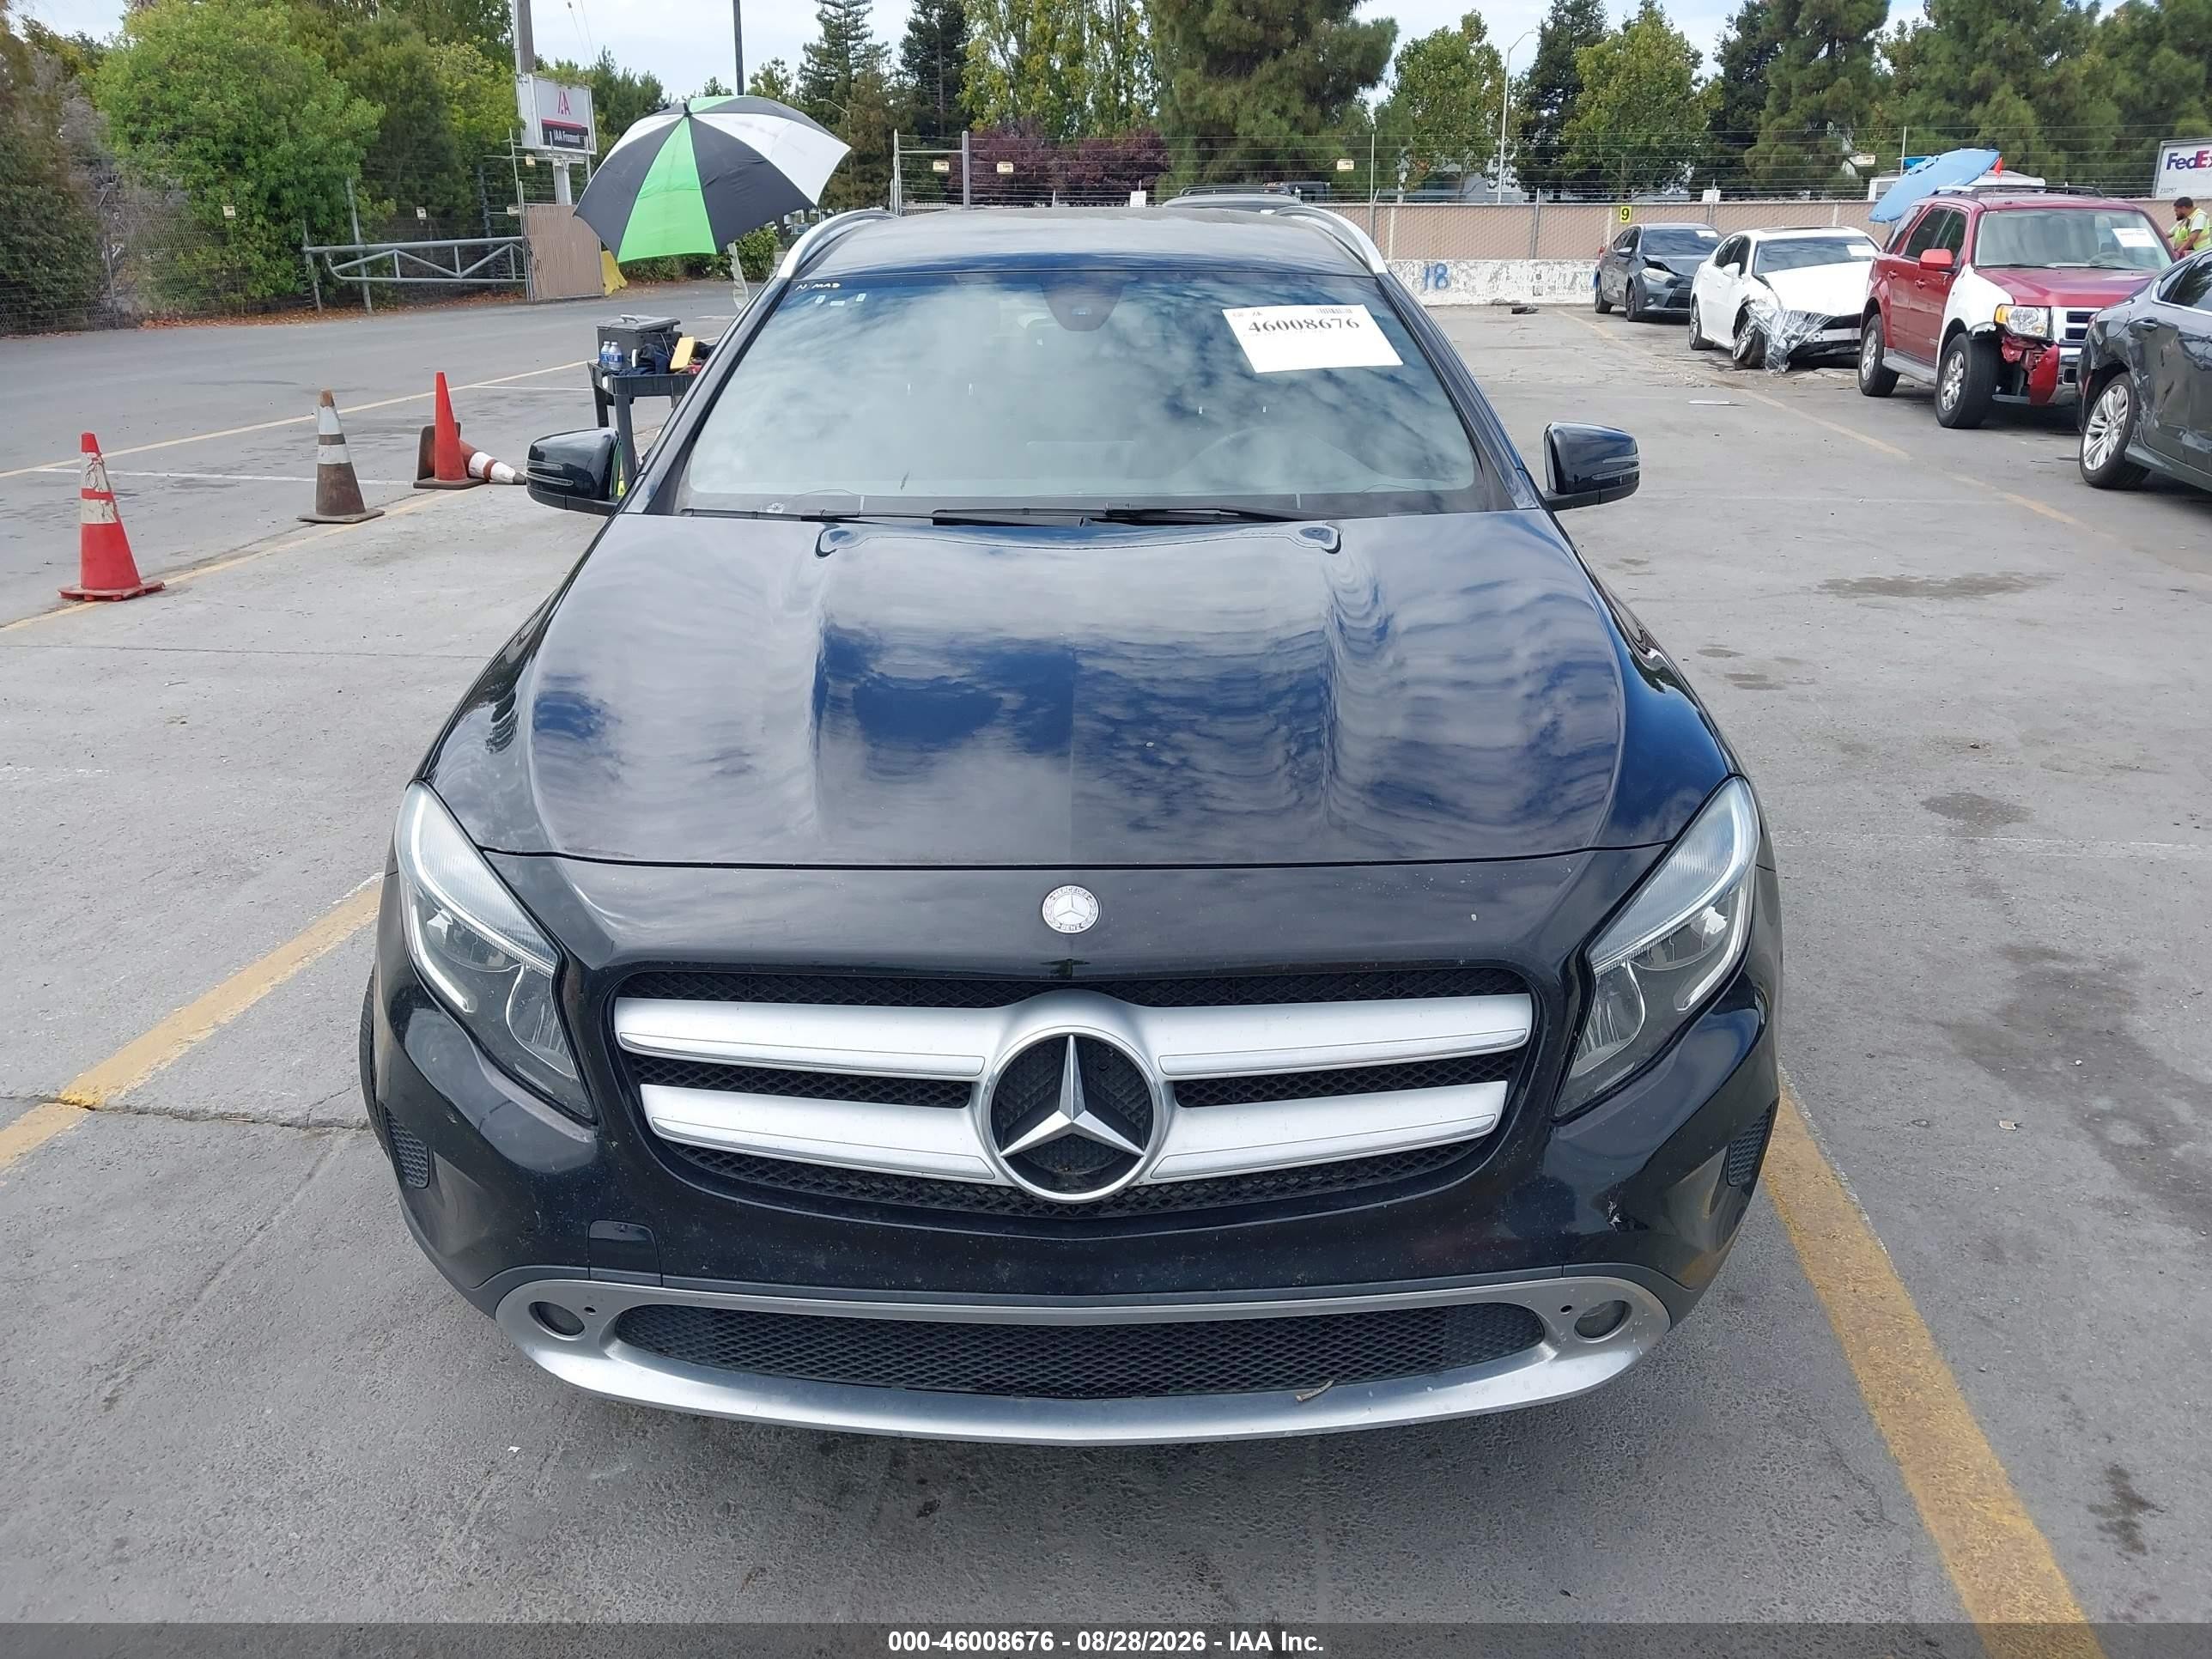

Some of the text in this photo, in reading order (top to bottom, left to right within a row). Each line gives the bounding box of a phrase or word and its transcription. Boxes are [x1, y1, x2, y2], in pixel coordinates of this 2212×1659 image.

[1621, 208, 1630, 220] 9
[1422, 262, 1449, 290] 18
[1249, 317, 1359, 332] 46008676
